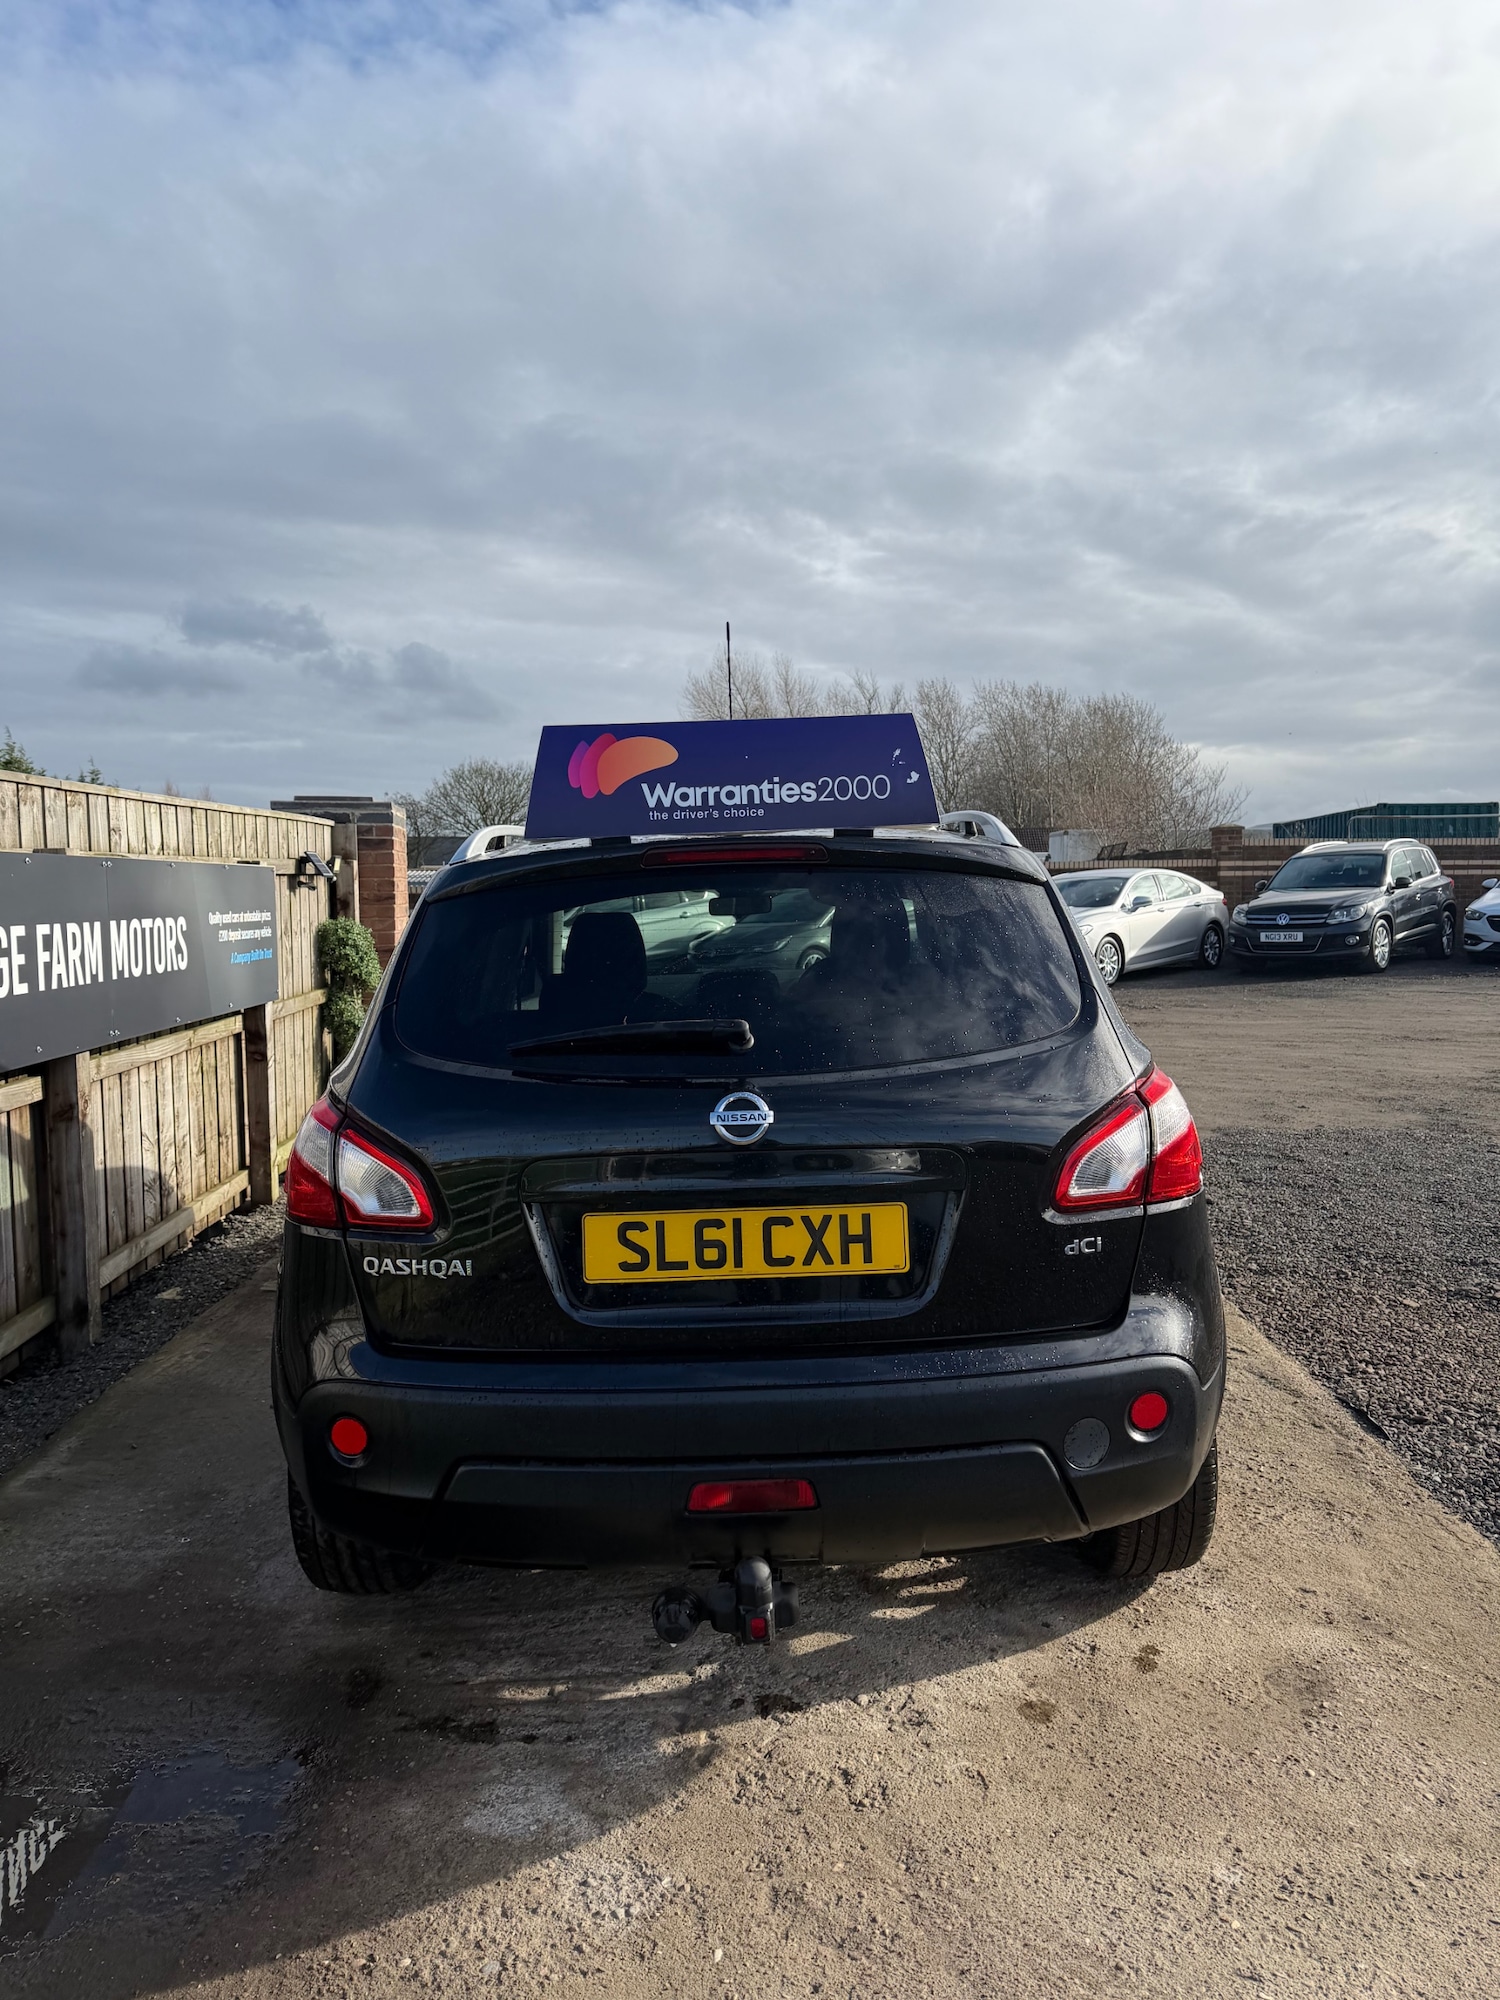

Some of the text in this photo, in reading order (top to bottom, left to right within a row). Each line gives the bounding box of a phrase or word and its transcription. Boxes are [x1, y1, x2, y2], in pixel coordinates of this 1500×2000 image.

[641, 774, 891, 808] Warranties2000
[649, 806, 765, 820] the driver's choice
[1283, 933, 1298, 941] XRU
[36, 921, 104, 992] FARM
[110, 916, 188, 980] MOTORS
[716, 1113, 767, 1122] NISSAN
[617, 1213, 873, 1273] SL61 CXH
[1064, 1236, 1102, 1255] dCi
[363, 1256, 473, 1279] QASHQAI
